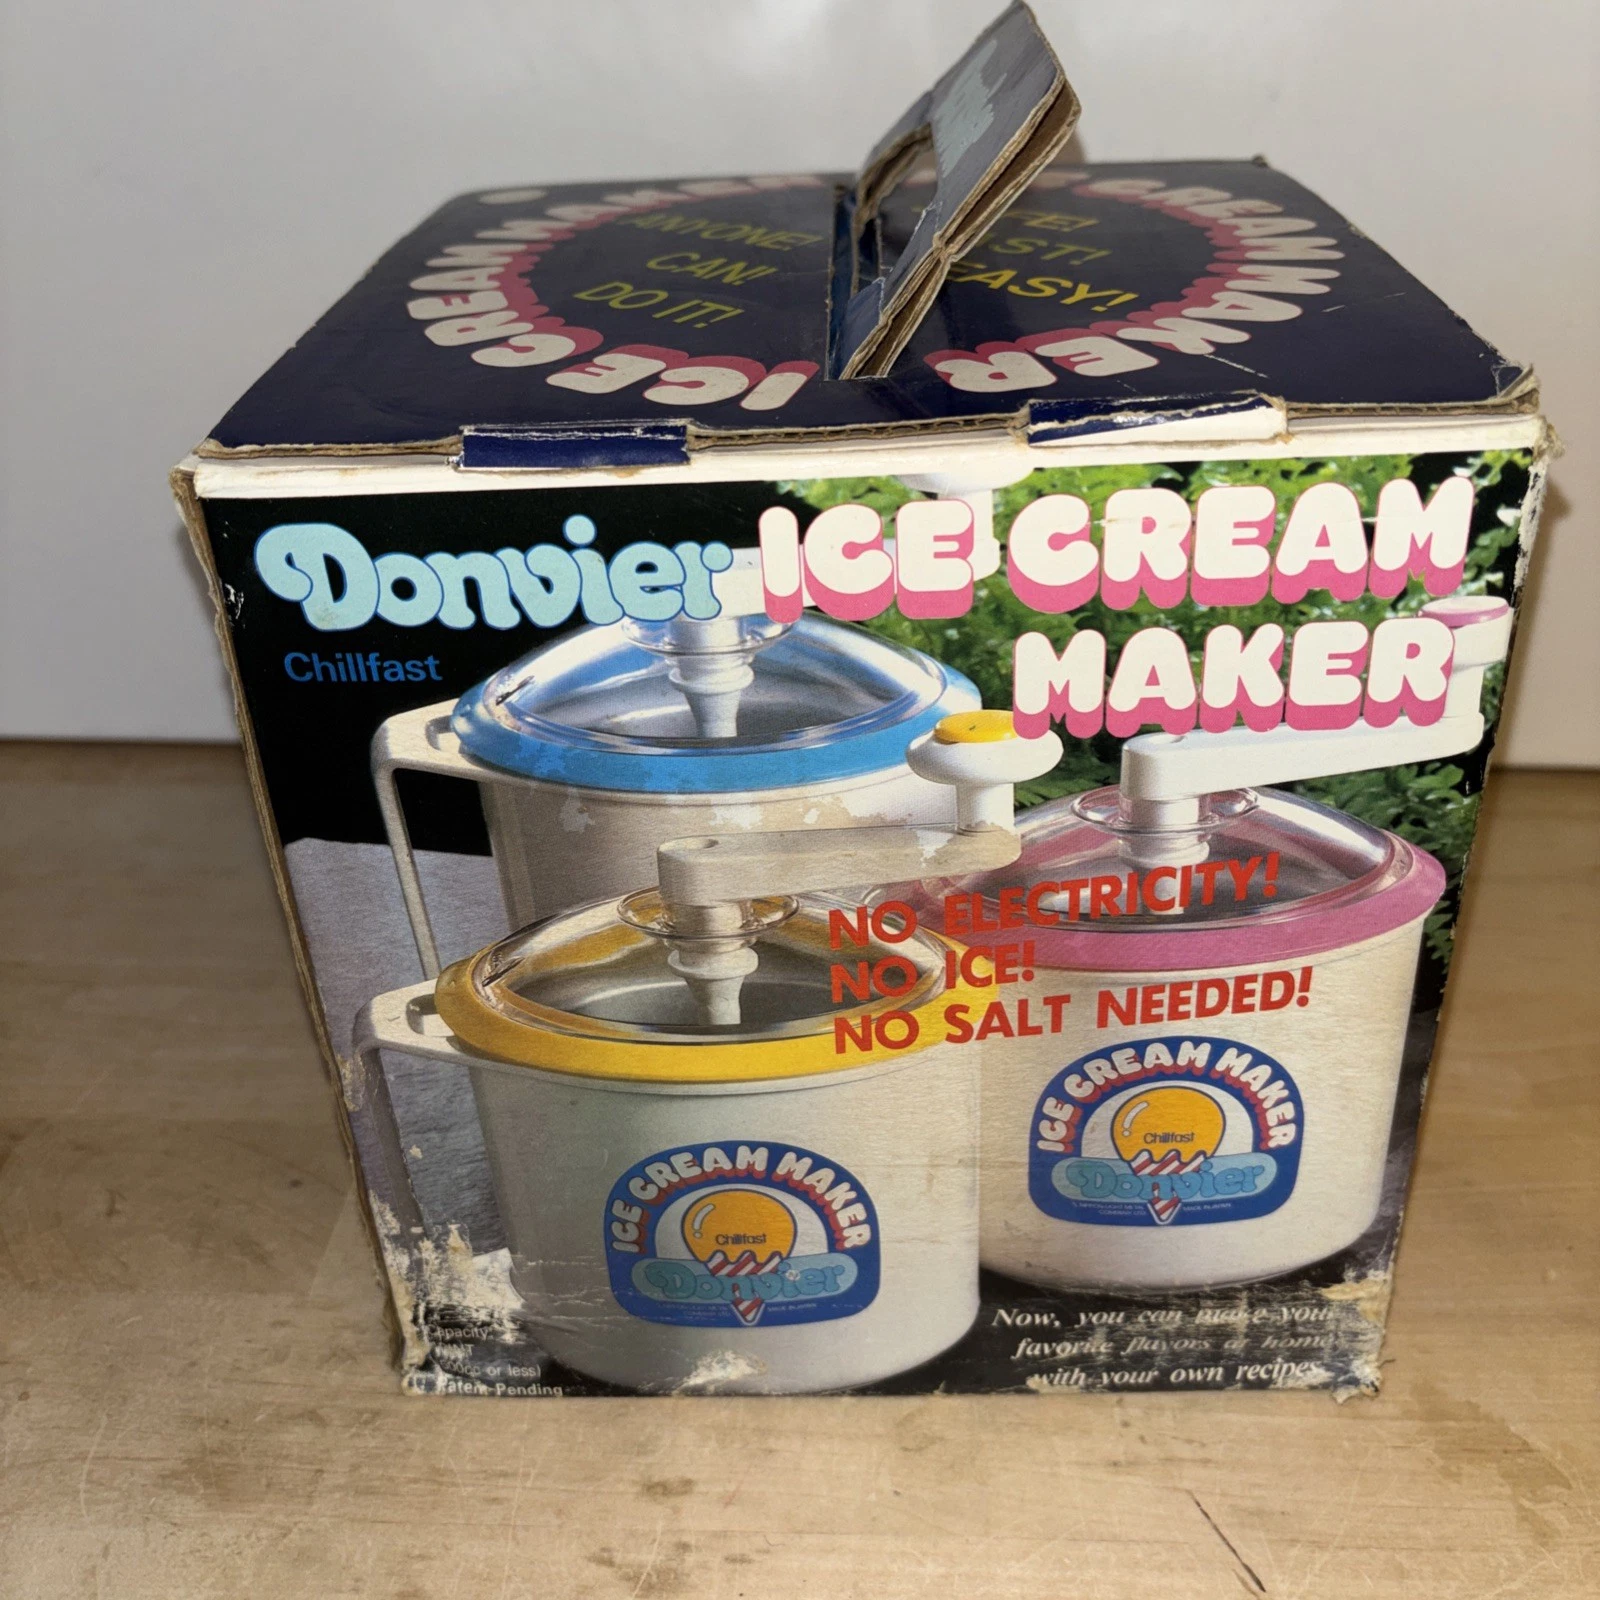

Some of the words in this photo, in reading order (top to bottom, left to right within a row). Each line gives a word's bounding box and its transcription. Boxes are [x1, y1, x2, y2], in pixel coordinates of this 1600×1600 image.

[645, 251, 779, 286] CAN!
[406, 240, 606, 368] CREAM
[572, 281, 670, 309] DO
[651, 298, 745, 329] IT!
[922, 260, 1343, 393] MAKER
[547, 344, 820, 411] ICE
[254, 514, 734, 632] Donvier
[758, 498, 976, 624] ICE
[1006, 475, 1475, 615] CREAM
[284, 652, 443, 684] Chillfast
[1012, 617, 1456, 740] MAKER
[829, 900, 918, 951] NO
[944, 851, 1281, 937] ELECTRICITY!
[830, 954, 918, 1003] NO
[944, 940, 1036, 990] ICE!
[834, 1010, 920, 1055] NO
[944, 994, 1071, 1044] SALT
[1096, 966, 1313, 1030] NEEDED!
[1037, 1096, 1083, 1154] ICE
[1064, 1040, 1212, 1103] CREAM
[1212, 1047, 1297, 1151] MAKER
[1143, 1131, 1196, 1144] Chillfast
[628, 1145, 769, 1206] CREAM
[772, 1151, 872, 1250] MAKER
[1065, 1160, 1265, 1199] Donvier
[611, 1199, 650, 1255] ICE
[715, 1233, 767, 1246] Chillfast
[645, 1260, 846, 1299] Donvier
[991, 1308, 1062, 1328] Now,
[1074, 1310, 1125, 1329] you
[436, 1376, 492, 1394] Paten
[496, 1383, 564, 1397] Pending
[486, 1365, 503, 1376] or
[508, 1363, 542, 1378] less)
[1100, 1369, 1160, 1385] your
[1169, 1366, 1226, 1384] own
